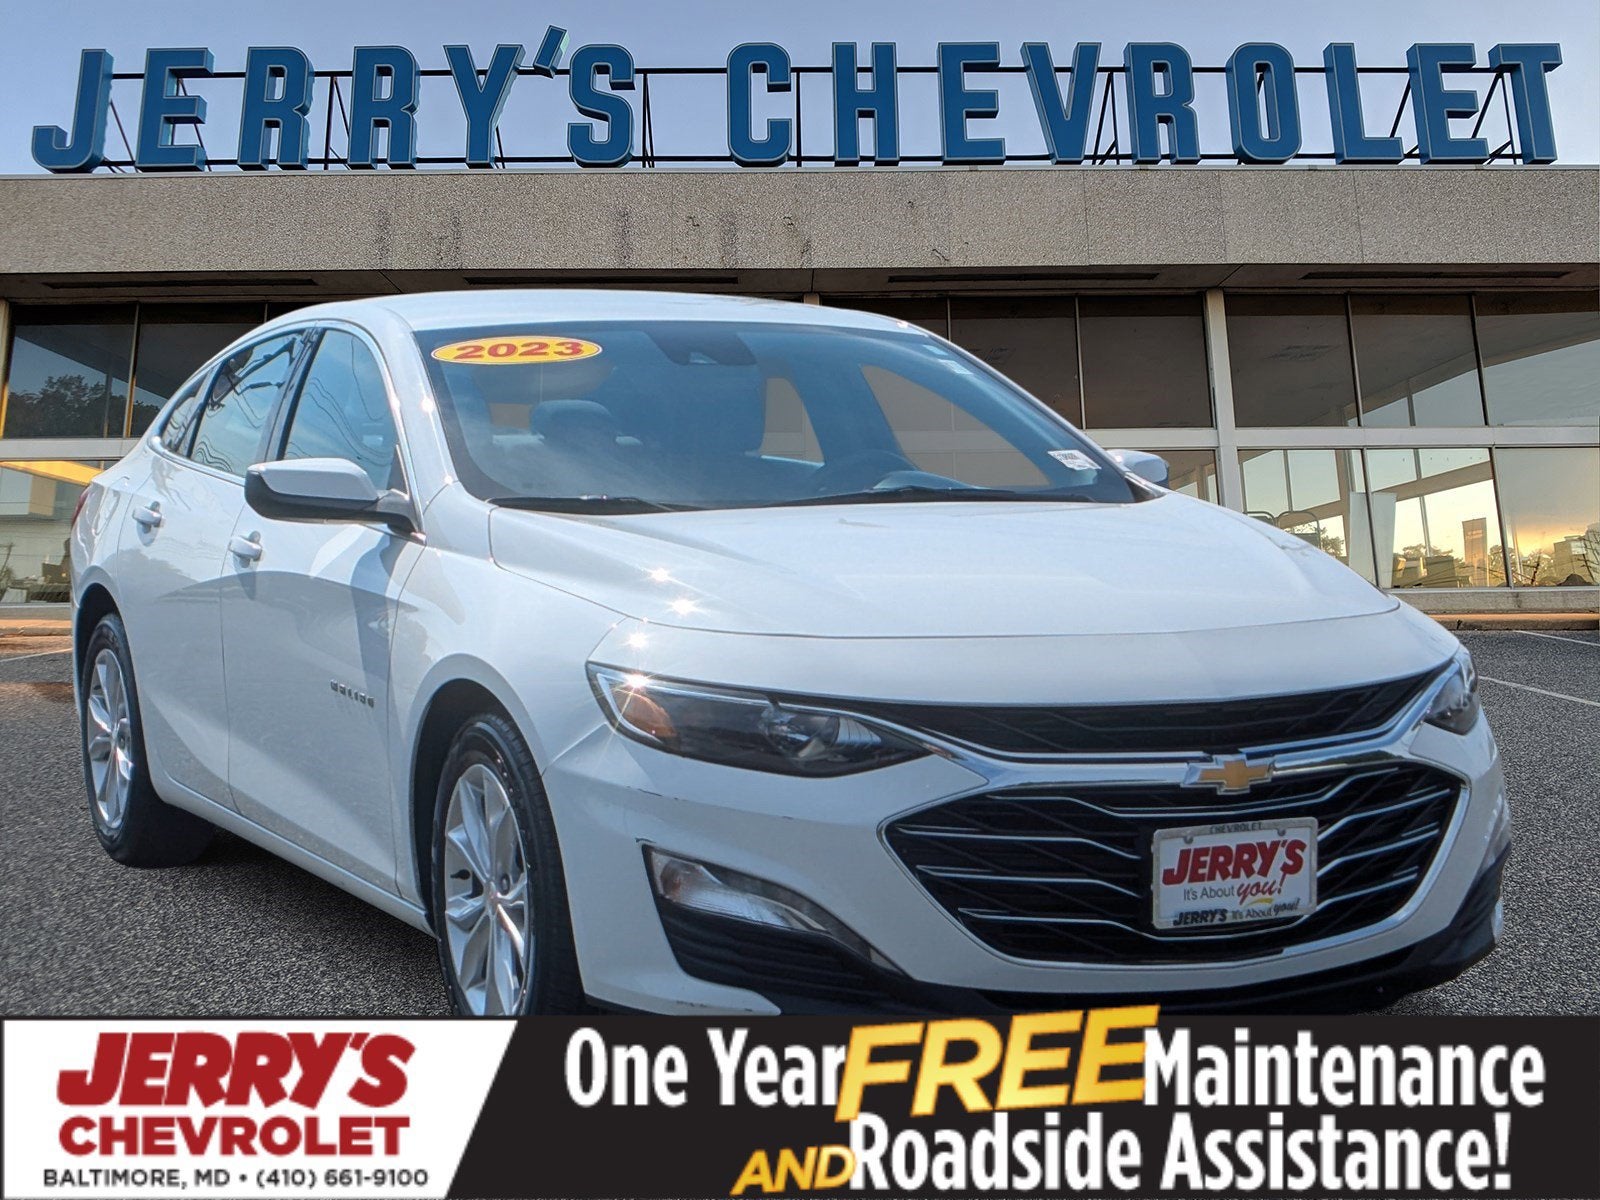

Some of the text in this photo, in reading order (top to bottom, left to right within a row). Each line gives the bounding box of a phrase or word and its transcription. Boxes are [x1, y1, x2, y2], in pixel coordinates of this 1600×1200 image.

[31, 25, 1562, 173] JERRY'S CHEVROLET
[453, 341, 584, 360] 2023
[1209, 821, 1263, 835] CHEVROLET
[1162, 839, 1307, 886] JERRY'S
[1184, 872, 1287, 905] It's About you!
[1173, 908, 1228, 926] JERRY'S
[1245, 906, 1272, 919] About
